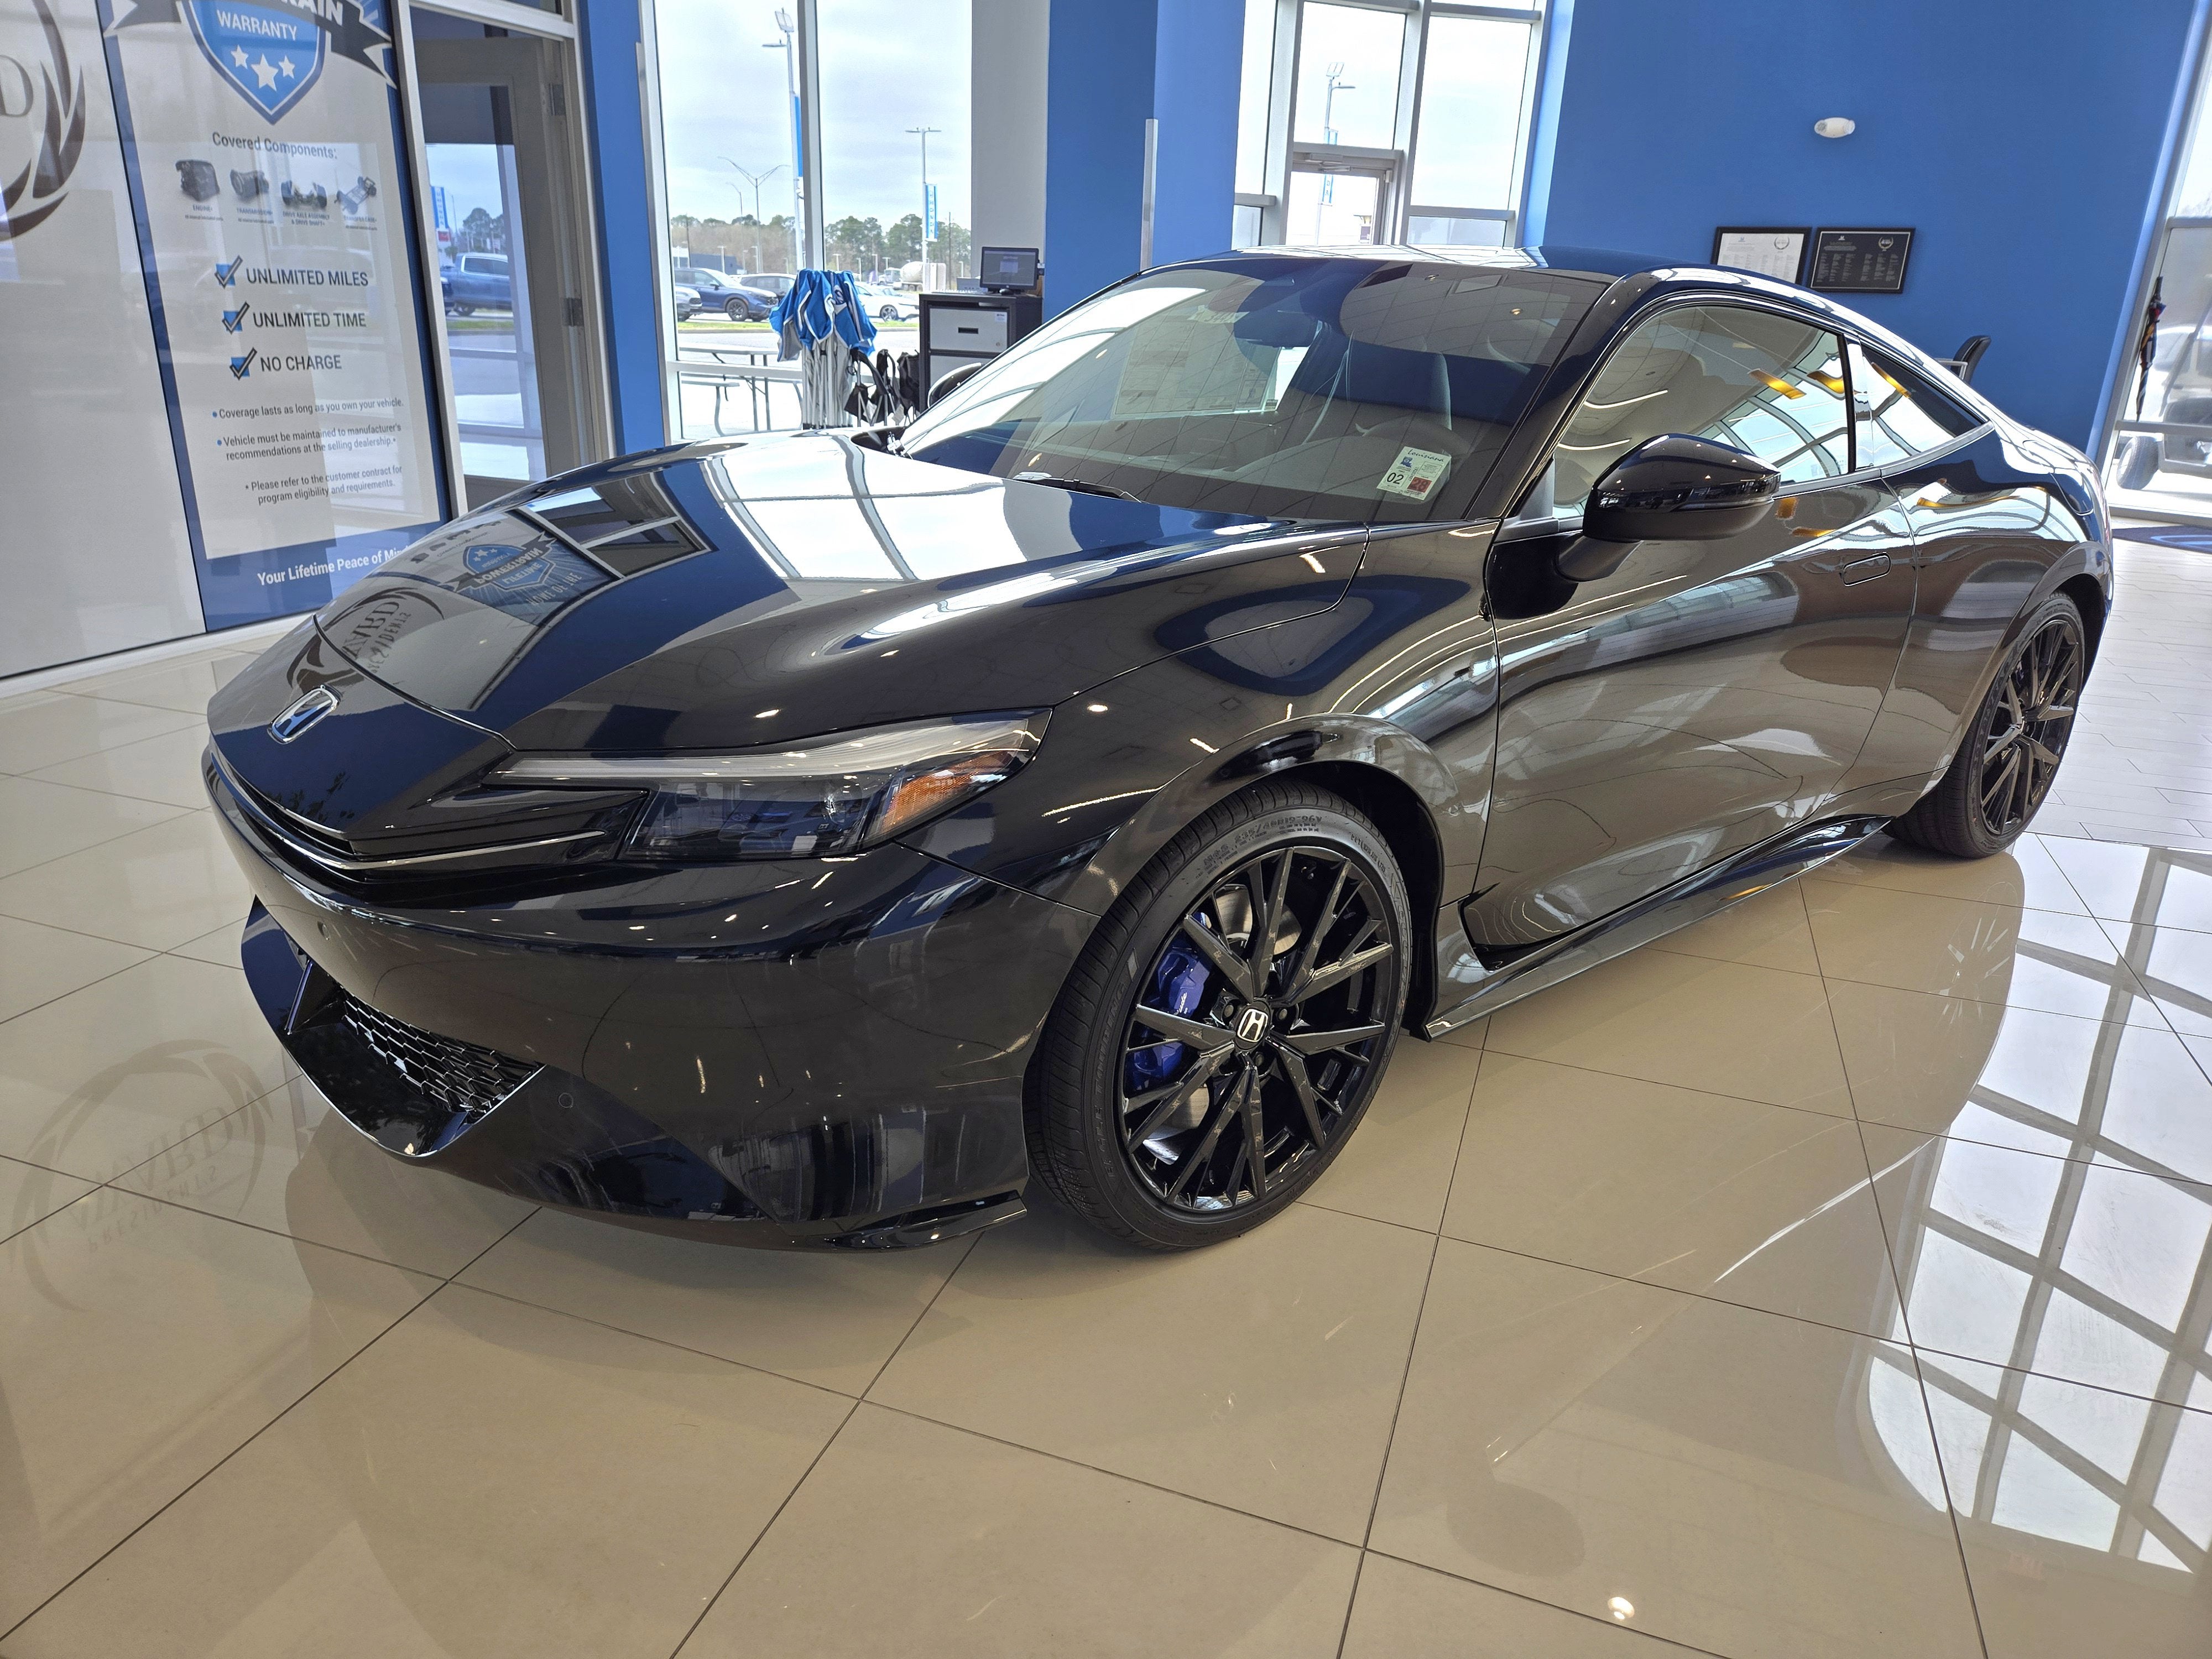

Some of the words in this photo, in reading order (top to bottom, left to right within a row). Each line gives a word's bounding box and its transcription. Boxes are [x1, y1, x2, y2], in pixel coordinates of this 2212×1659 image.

[216, 9, 297, 41] WARRANTY
[212, 132, 260, 151] Covered
[264, 137, 337, 159] Components:
[246, 268, 324, 285] UNLIMITED
[328, 272, 368, 286] MILES
[253, 312, 330, 327] UNLIMITED
[333, 312, 367, 327] TIME
[260, 357, 281, 372] NO
[285, 354, 342, 371] CHARGE
[219, 408, 260, 419] Coverage
[261, 405, 281, 416] lasts
[295, 403, 313, 415] long
[326, 403, 340, 413] you
[359, 400, 375, 411] your
[377, 397, 404, 408] vehicle.
[223, 434, 255, 447] Vehicle
[257, 434, 279, 444] must
[280, 431, 291, 442] be
[293, 427, 336, 441] maintained
[338, 428, 346, 436] to
[347, 423, 401, 436] manufacturer's
[226, 445, 301, 461] recommendations
[304, 444, 311, 453] at
[314, 442, 326, 452] the
[327, 440, 352, 451] selling
[251, 480, 279, 491] Please
[281, 477, 299, 488] refer
[311, 474, 324, 484] the
[326, 471, 360, 482] customer
[362, 467, 391, 477] contract
[392, 465, 403, 473] for
[1386, 472, 1404, 484] 02
[258, 492, 293, 506] program
[294, 487, 329, 500] eligibility
[346, 479, 395, 493] requirements.
[257, 571, 286, 586] Your
[288, 562, 335, 580] Lifetime
[337, 555, 369, 571] Peace
[371, 550, 382, 564] of
